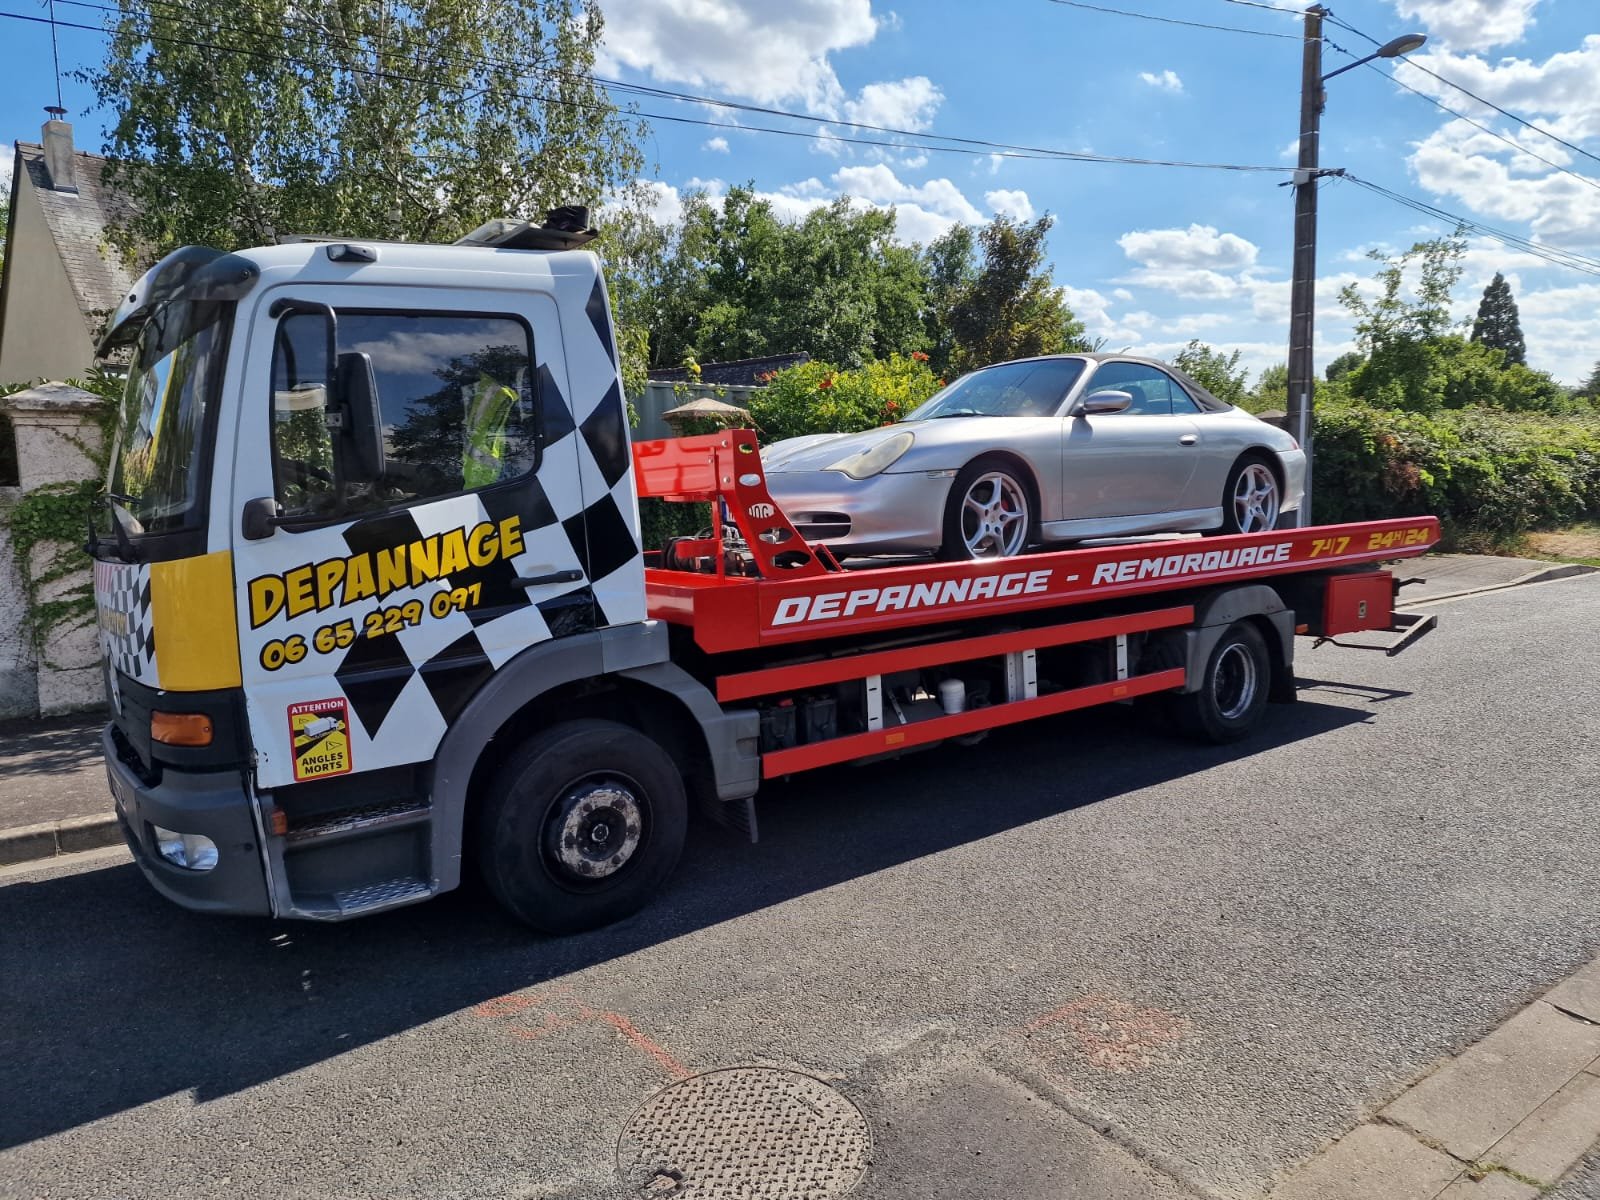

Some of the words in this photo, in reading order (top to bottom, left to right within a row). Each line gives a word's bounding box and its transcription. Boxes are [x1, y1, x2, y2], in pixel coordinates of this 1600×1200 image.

[249, 515, 525, 629] DEPANNAGE
[771, 569, 1053, 626] DEPANNAGE
[1092, 542, 1293, 585] REMORQUAGE
[260, 634, 308, 671] 06
[313, 618, 357, 654] 65
[364, 599, 424, 639] 229
[291, 700, 344, 714] ATTENTION
[302, 752, 343, 766] ANGLES
[305, 761, 342, 775] MORTS
